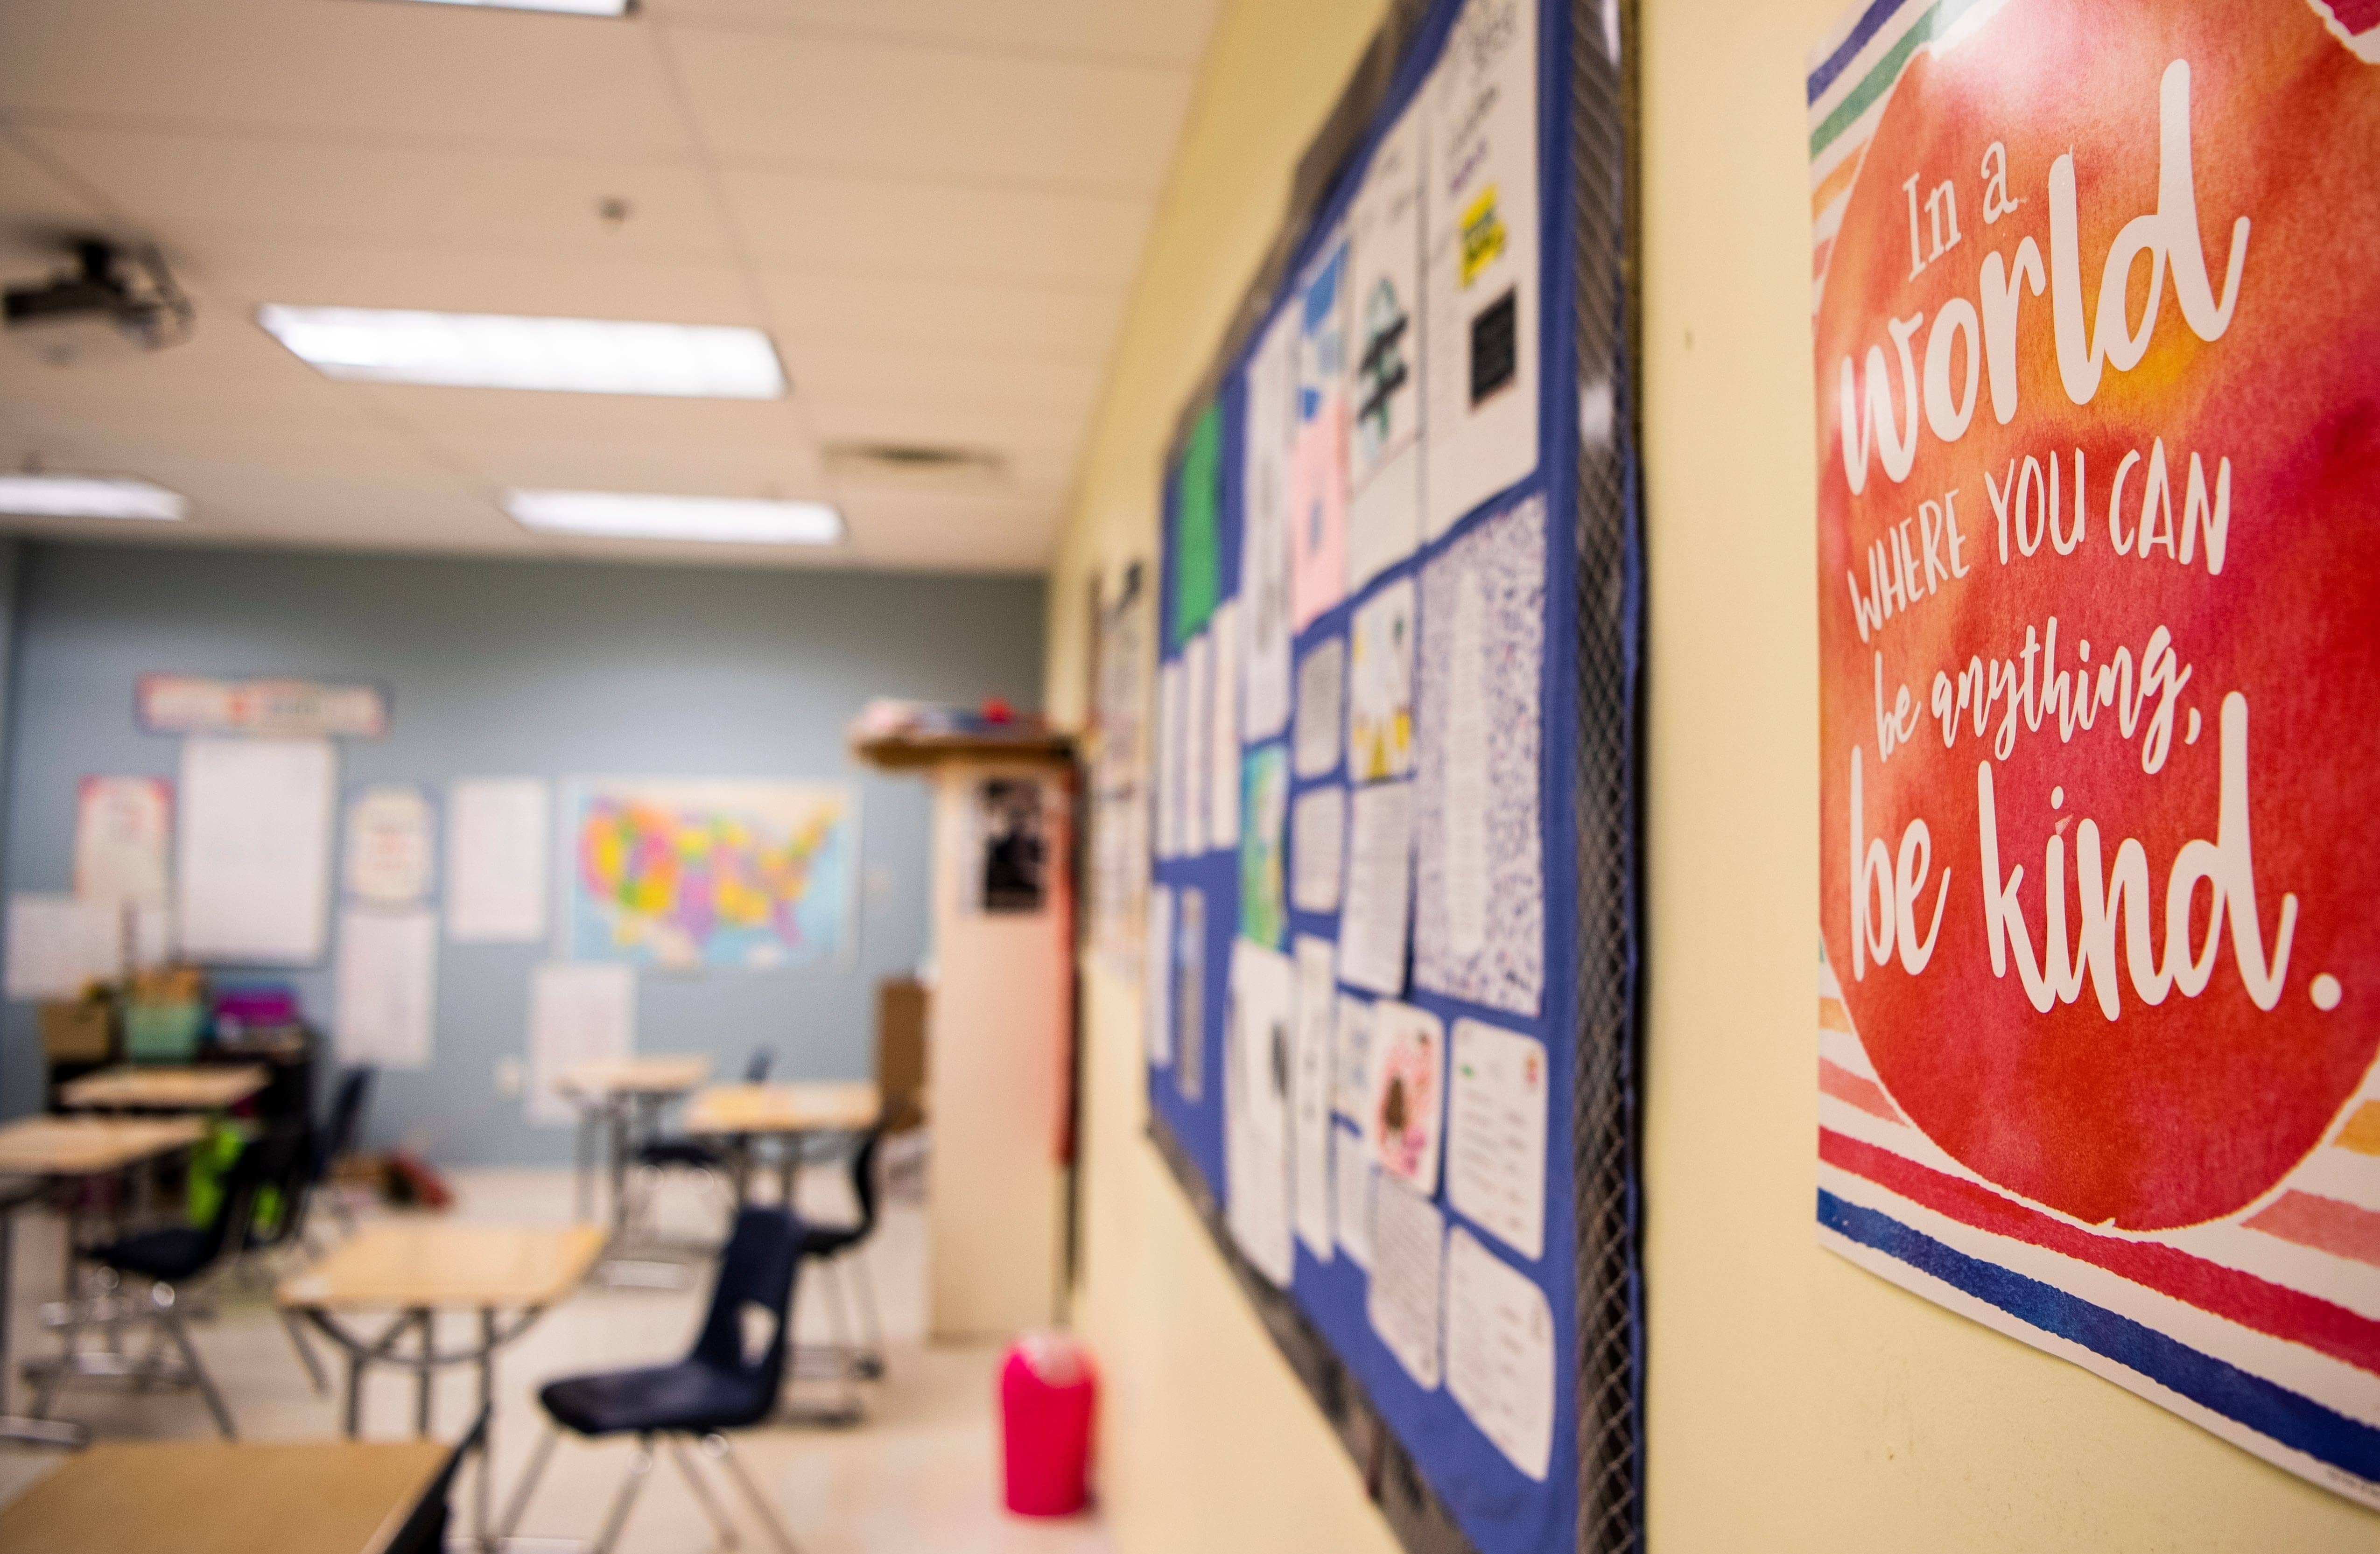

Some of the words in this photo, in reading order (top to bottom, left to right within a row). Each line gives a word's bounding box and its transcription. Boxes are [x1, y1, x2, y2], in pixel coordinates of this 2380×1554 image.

[1840, 58, 2251, 496] world
[1903, 172, 1961, 282] In
[1980, 141, 2018, 224] a
[1847, 489, 1970, 643] WHERE
[1985, 448, 2085, 565] YOU
[2109, 436, 2231, 575] CAN
[1874, 650, 1921, 763] be
[1932, 616, 2201, 775] anything,
[1850, 744, 1951, 982] be
[1977, 691, 2342, 1021] kind.
